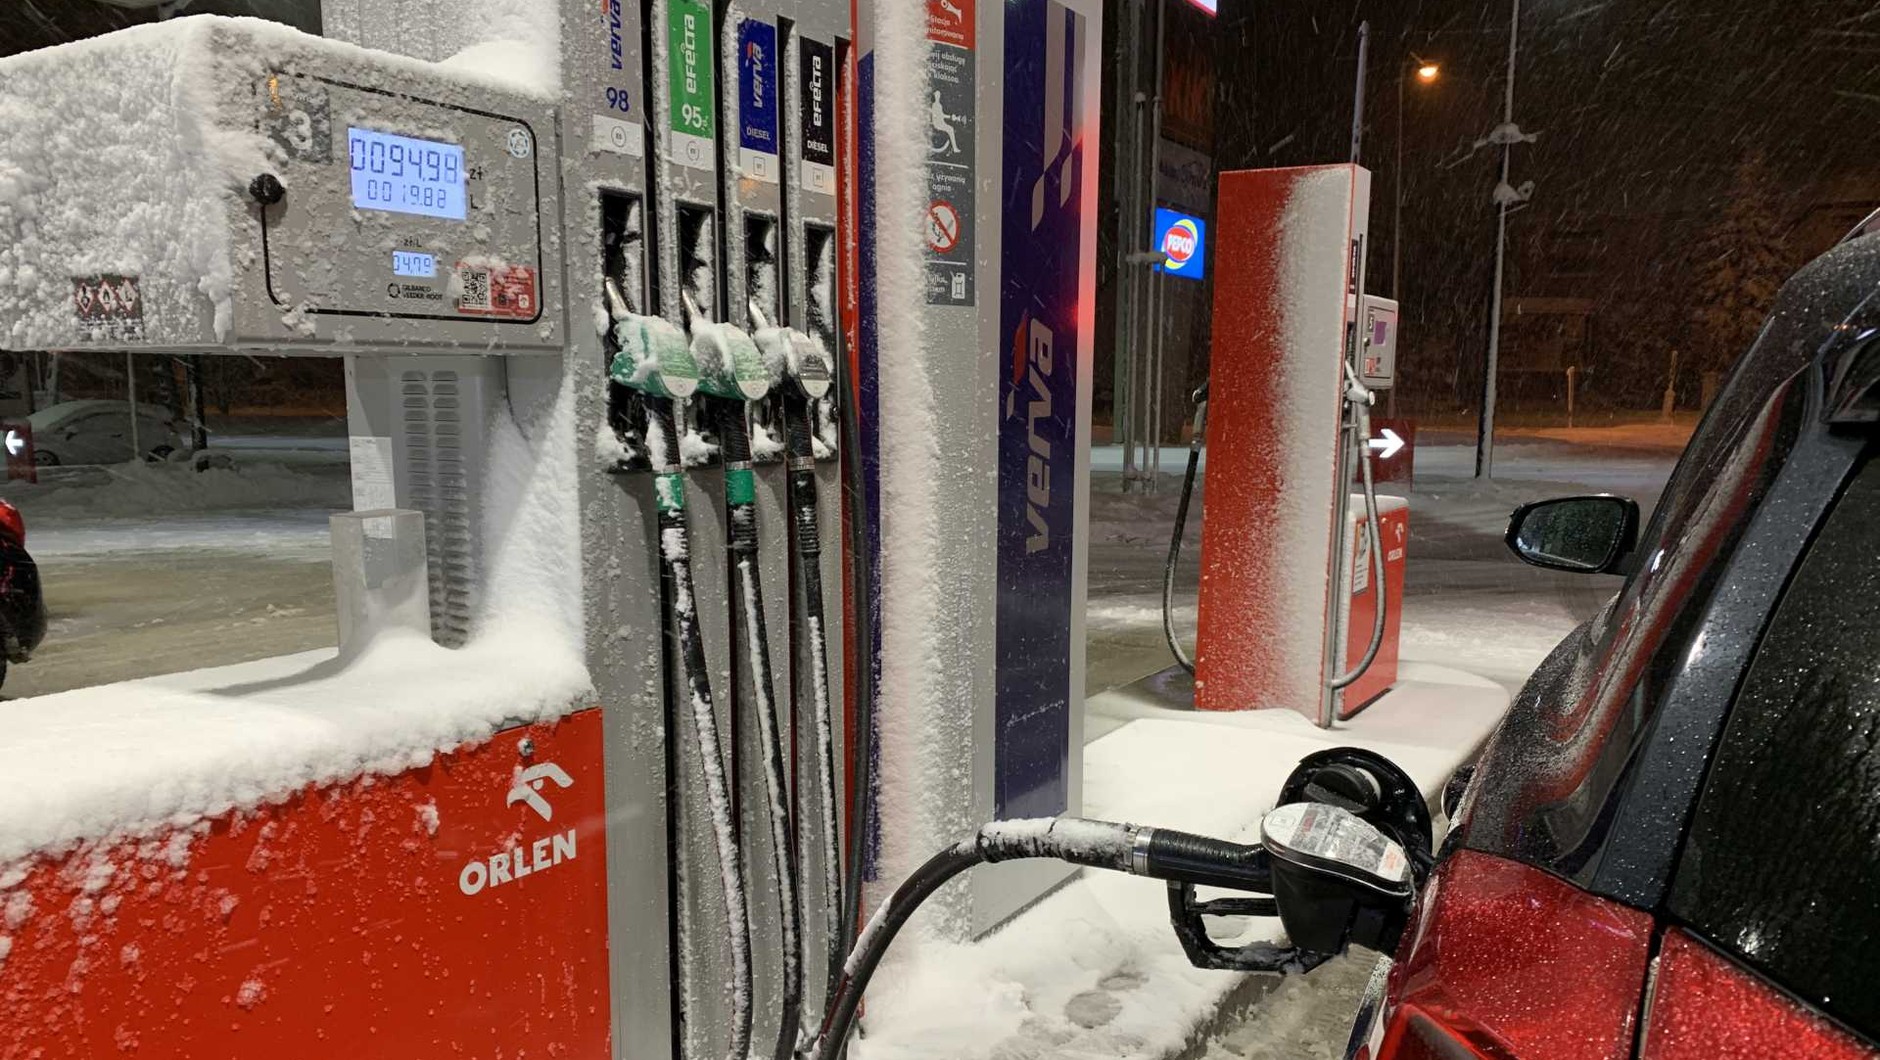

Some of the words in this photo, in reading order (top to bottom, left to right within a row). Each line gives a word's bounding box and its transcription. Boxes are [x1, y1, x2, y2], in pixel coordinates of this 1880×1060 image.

[752, 42, 763, 109] verva
[605, 86, 629, 112] 98
[681, 103, 702, 128] 95
[285, 109, 312, 150] 3
[746, 127, 771, 141] DIESEL
[807, 139, 828, 153] DIESEL
[469, 193, 479, 209] L
[1166, 233, 1194, 255] PEPCO
[1025, 317, 1053, 555] verva
[459, 829, 577, 895] ORLEN
